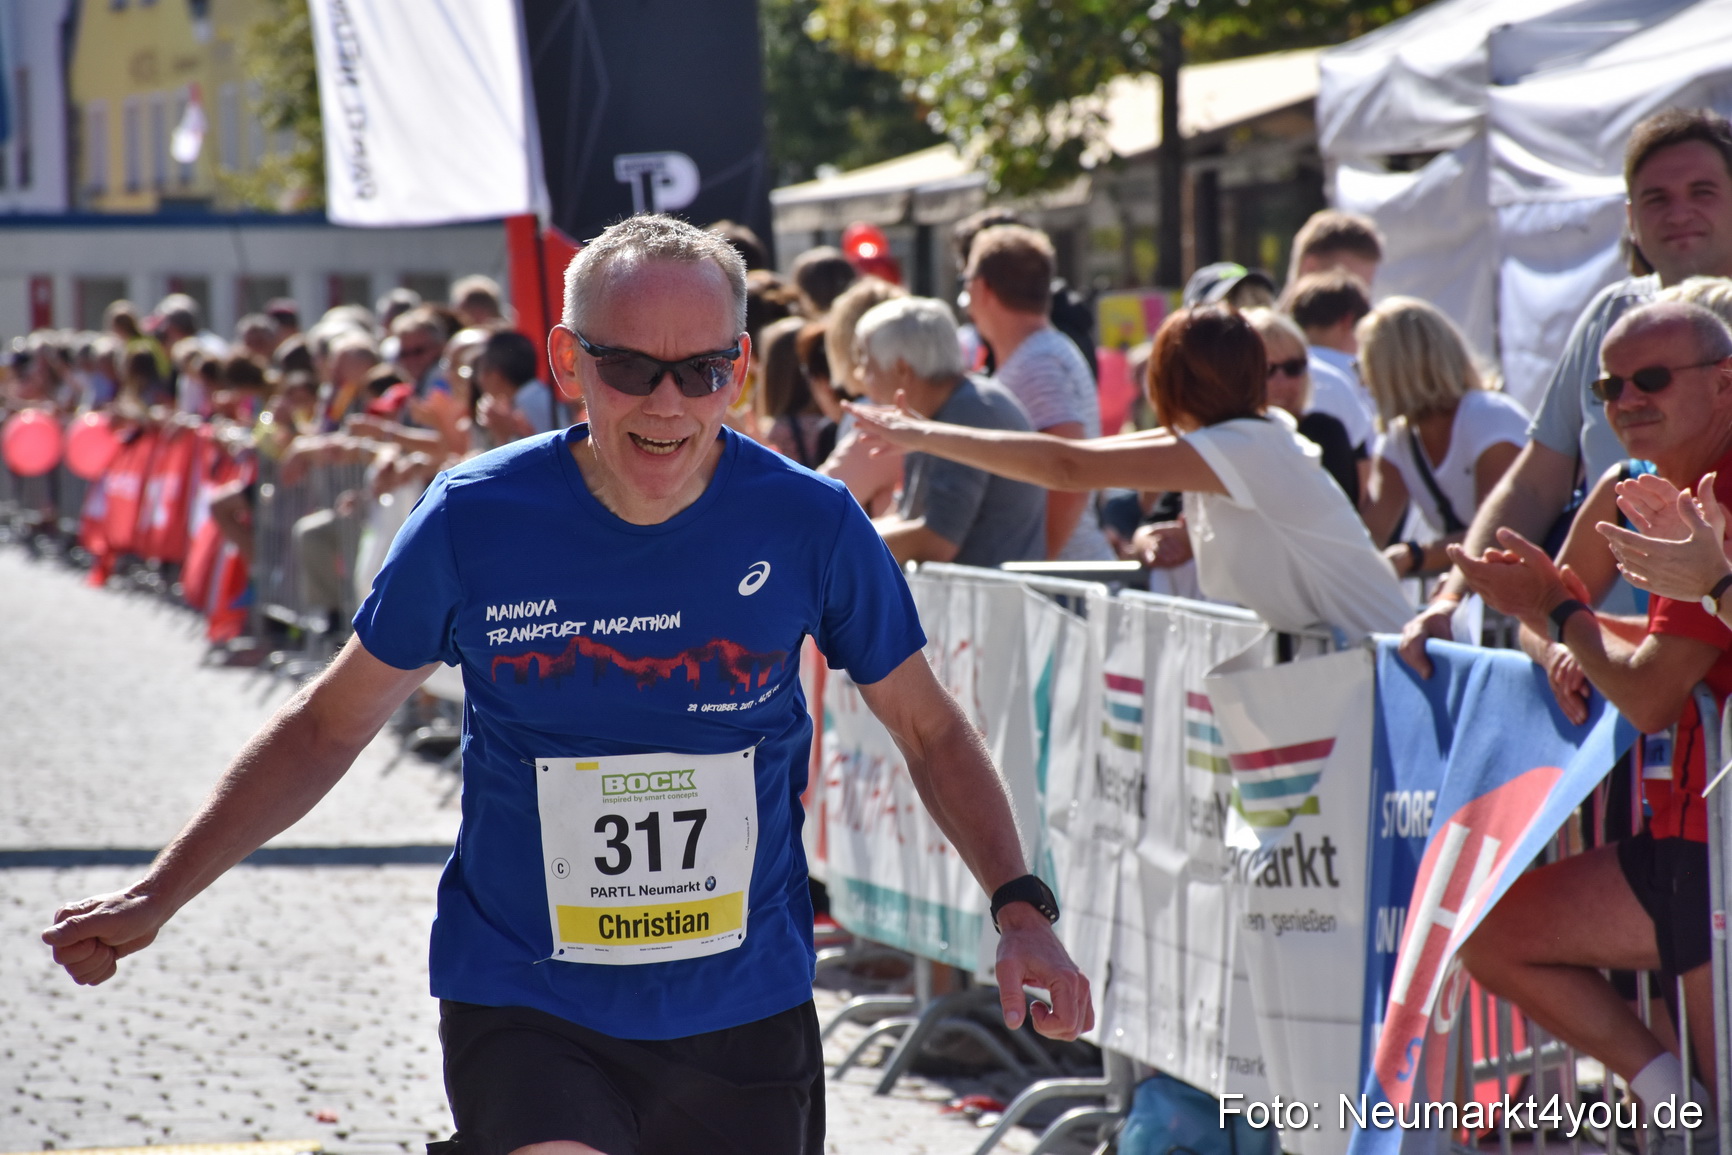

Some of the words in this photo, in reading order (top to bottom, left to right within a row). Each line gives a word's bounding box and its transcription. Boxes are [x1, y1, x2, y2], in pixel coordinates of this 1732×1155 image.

[486, 599, 557, 622] MAINOVA
[486, 620, 587, 646] FRANKFURT
[592, 610, 681, 636] MARATHON
[701, 702, 738, 712] OKTOBER
[602, 769, 697, 796] BOCK
[602, 795, 632, 805] inspired
[634, 794, 643, 803] by
[644, 793, 666, 801] smart
[667, 791, 698, 800] concepts
[1381, 789, 1436, 839] STORE
[594, 808, 707, 876] 317
[557, 862, 564, 874] C
[590, 886, 636, 899] PARTL
[639, 881, 701, 897] Neumarkt
[599, 910, 709, 940] Christian
